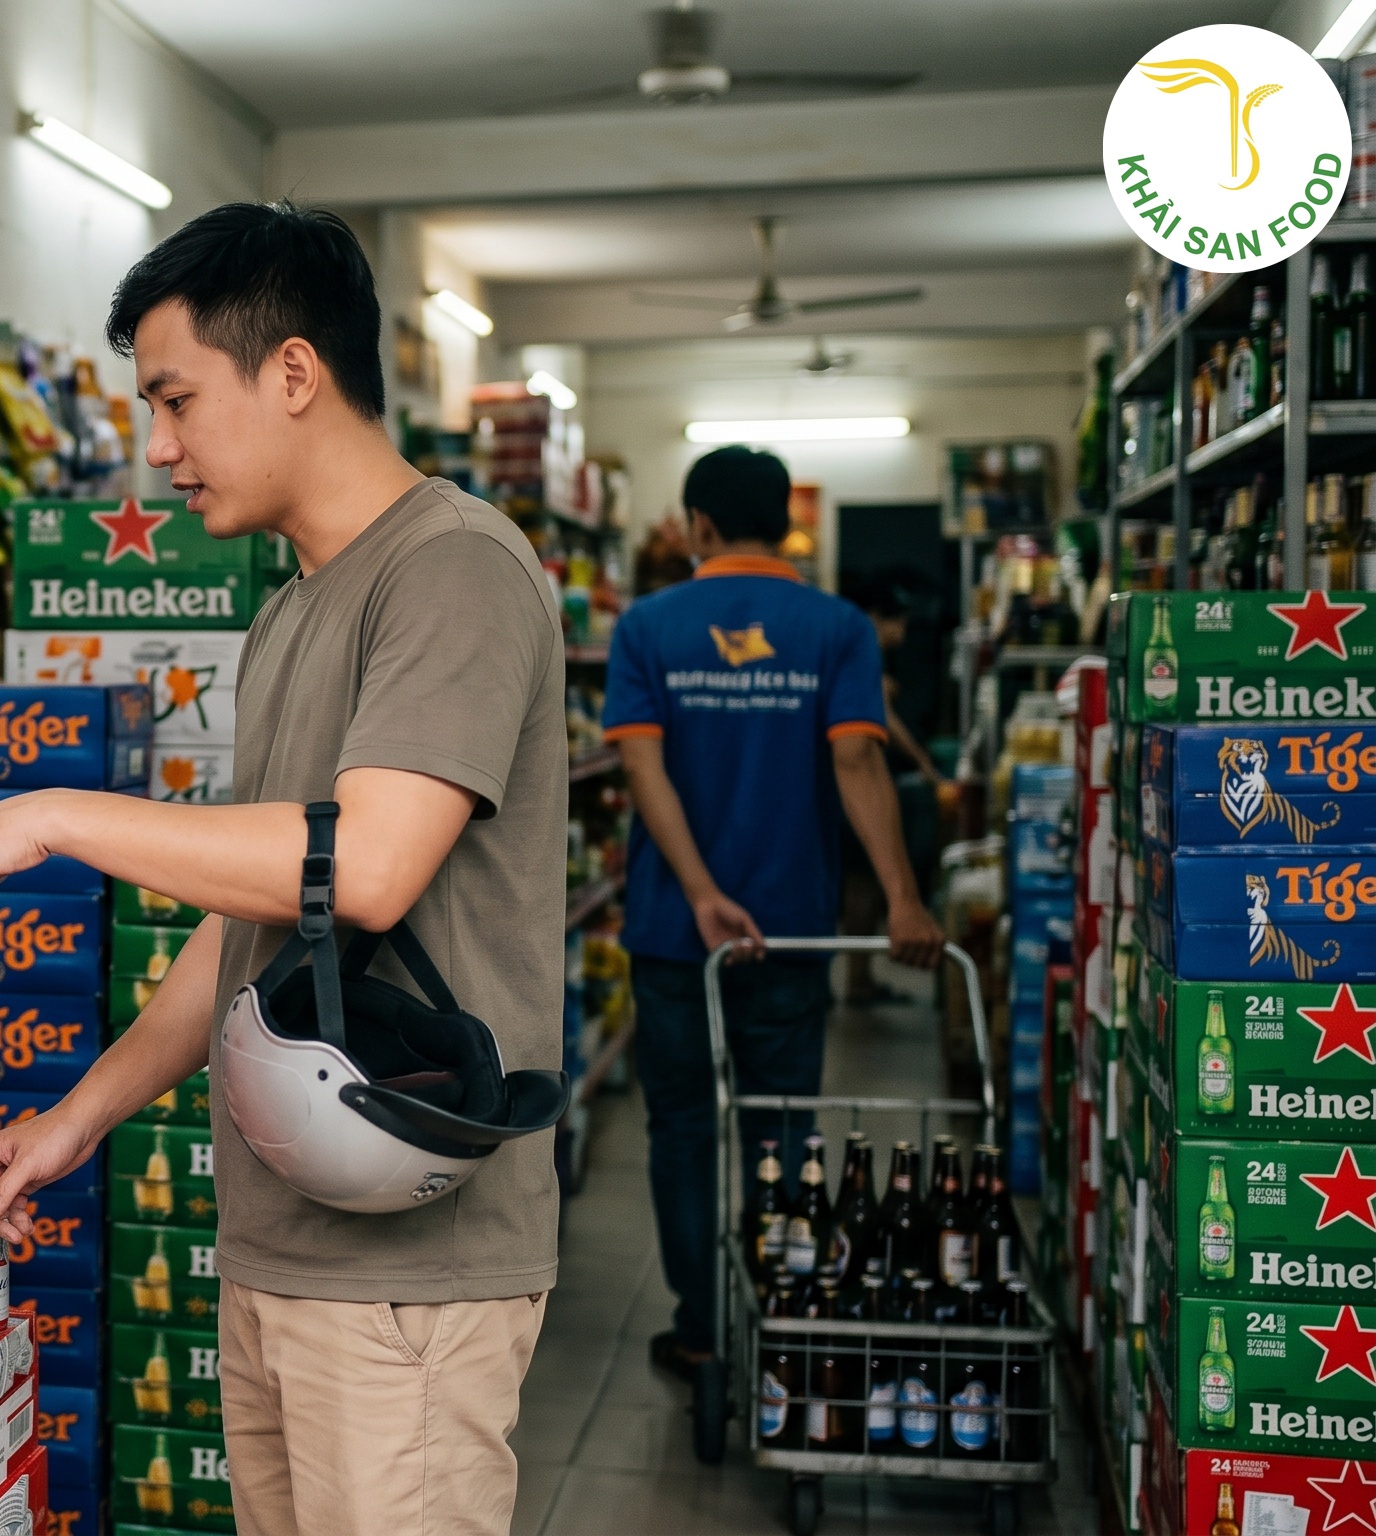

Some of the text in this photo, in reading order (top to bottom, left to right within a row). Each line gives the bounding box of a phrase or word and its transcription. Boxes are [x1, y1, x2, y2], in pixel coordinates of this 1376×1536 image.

[30, 578, 234, 618] Heineken
[1195, 601, 1224, 620] 24
[1244, 995, 1276, 1016] 24
[1248, 1084, 1376, 1120] Heine
[1246, 1161, 1276, 1182] 24
[1249, 1252, 1376, 1290] Heine
[1246, 1312, 1277, 1333] 24
[1249, 1402, 1376, 1442] Heine
[1210, 1457, 1232, 1473] 24
